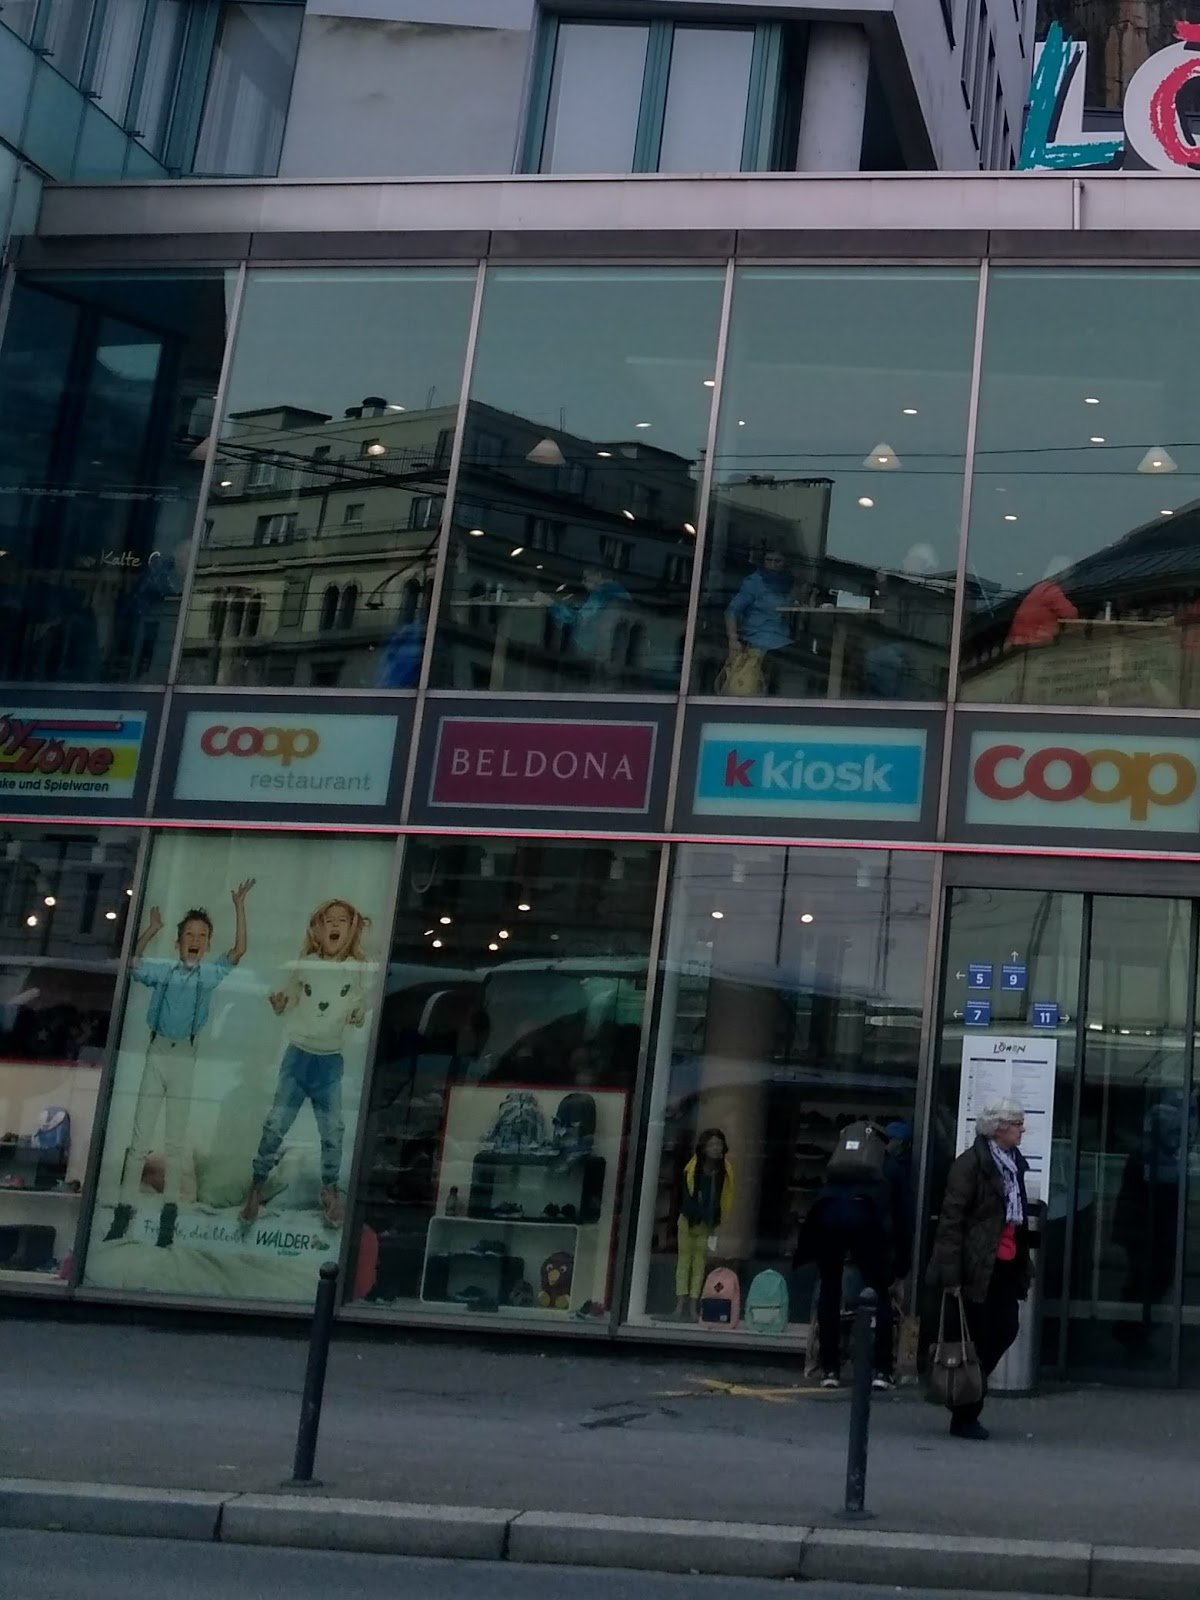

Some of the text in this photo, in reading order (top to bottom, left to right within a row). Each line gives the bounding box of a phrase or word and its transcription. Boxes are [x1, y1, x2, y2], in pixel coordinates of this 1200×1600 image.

[200, 725, 319, 766] coop
[450, 747, 634, 780] BELDONA
[724, 749, 894, 792] k kiosk
[18, 779, 42, 790] und
[44, 779, 109, 793] Spielwaren
[250, 770, 372, 791] restaurant
[974, 745, 1198, 822] coop
[975, 973, 984, 984] 5
[1009, 974, 1018, 985] 9
[973, 1010, 982, 1021] 7
[1039, 1012, 1051, 1023] 11
